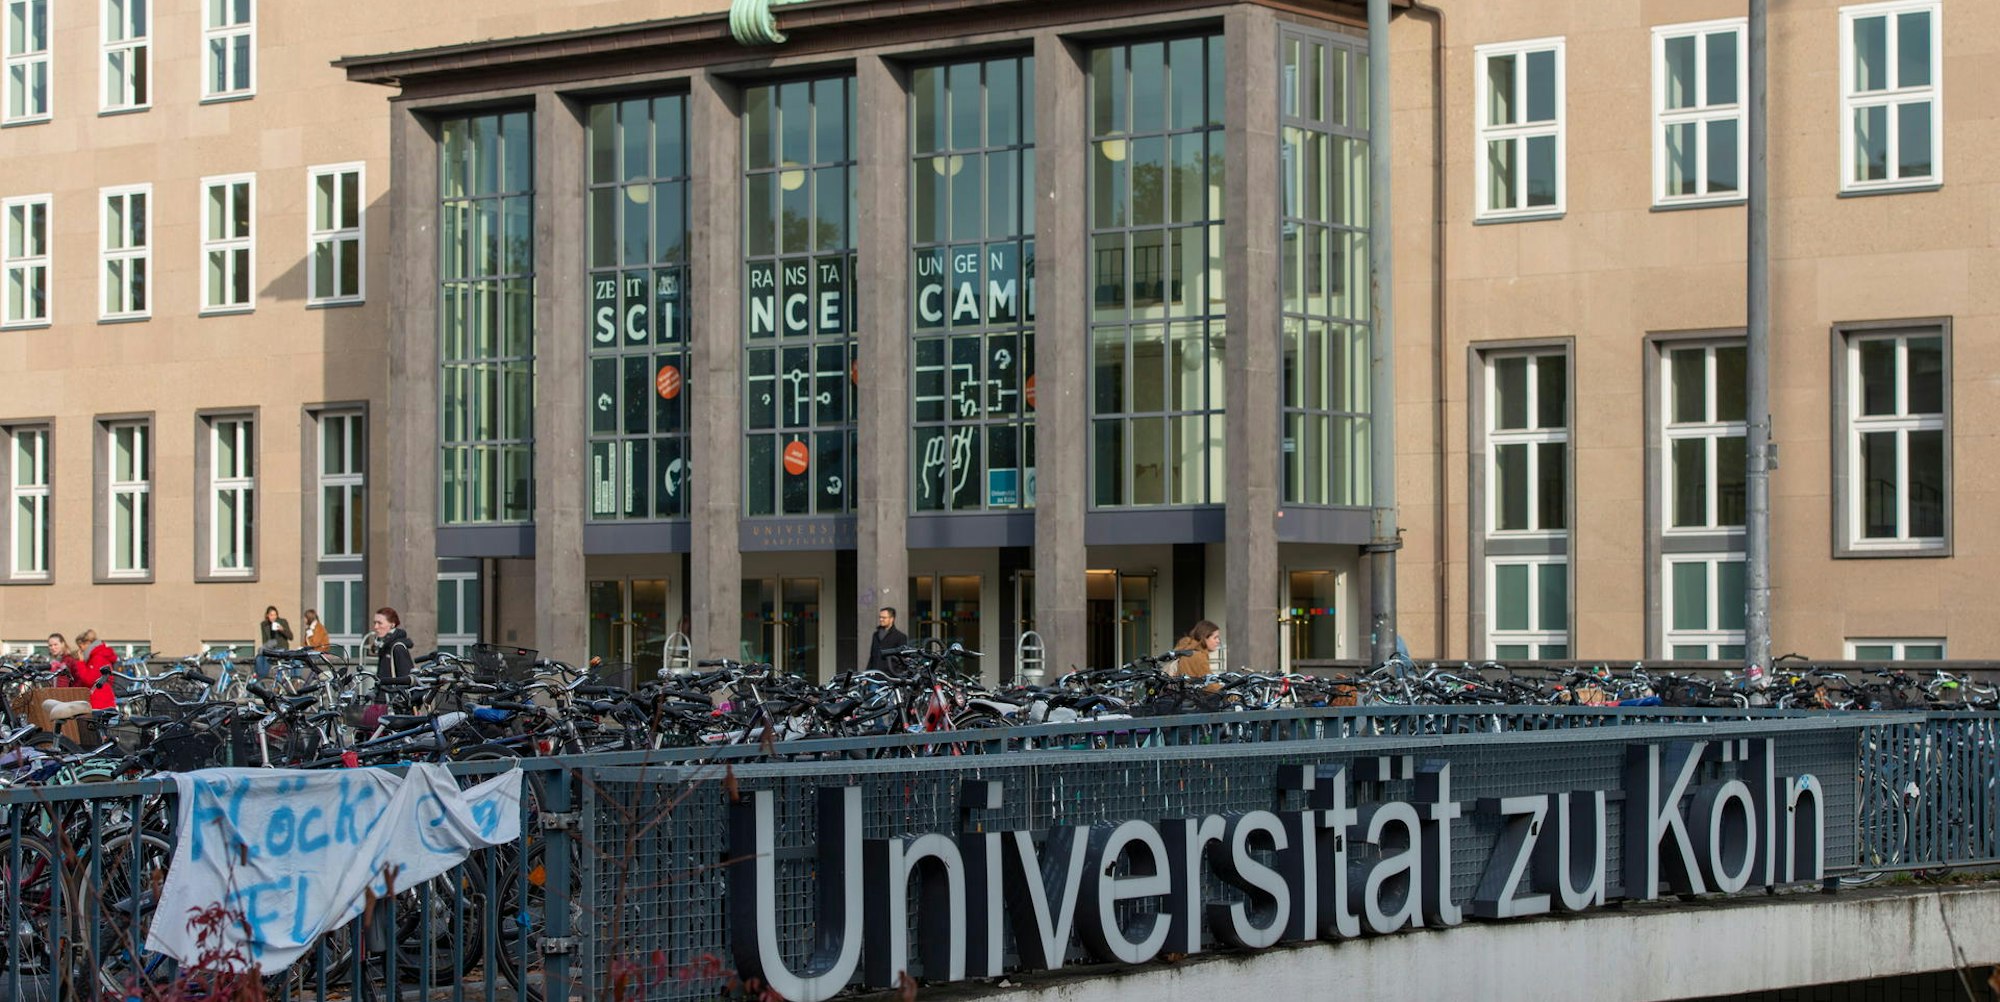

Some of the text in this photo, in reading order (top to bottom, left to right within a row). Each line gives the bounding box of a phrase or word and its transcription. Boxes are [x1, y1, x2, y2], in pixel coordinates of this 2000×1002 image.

[752, 737, 1825, 1001] Universität zu Köln
